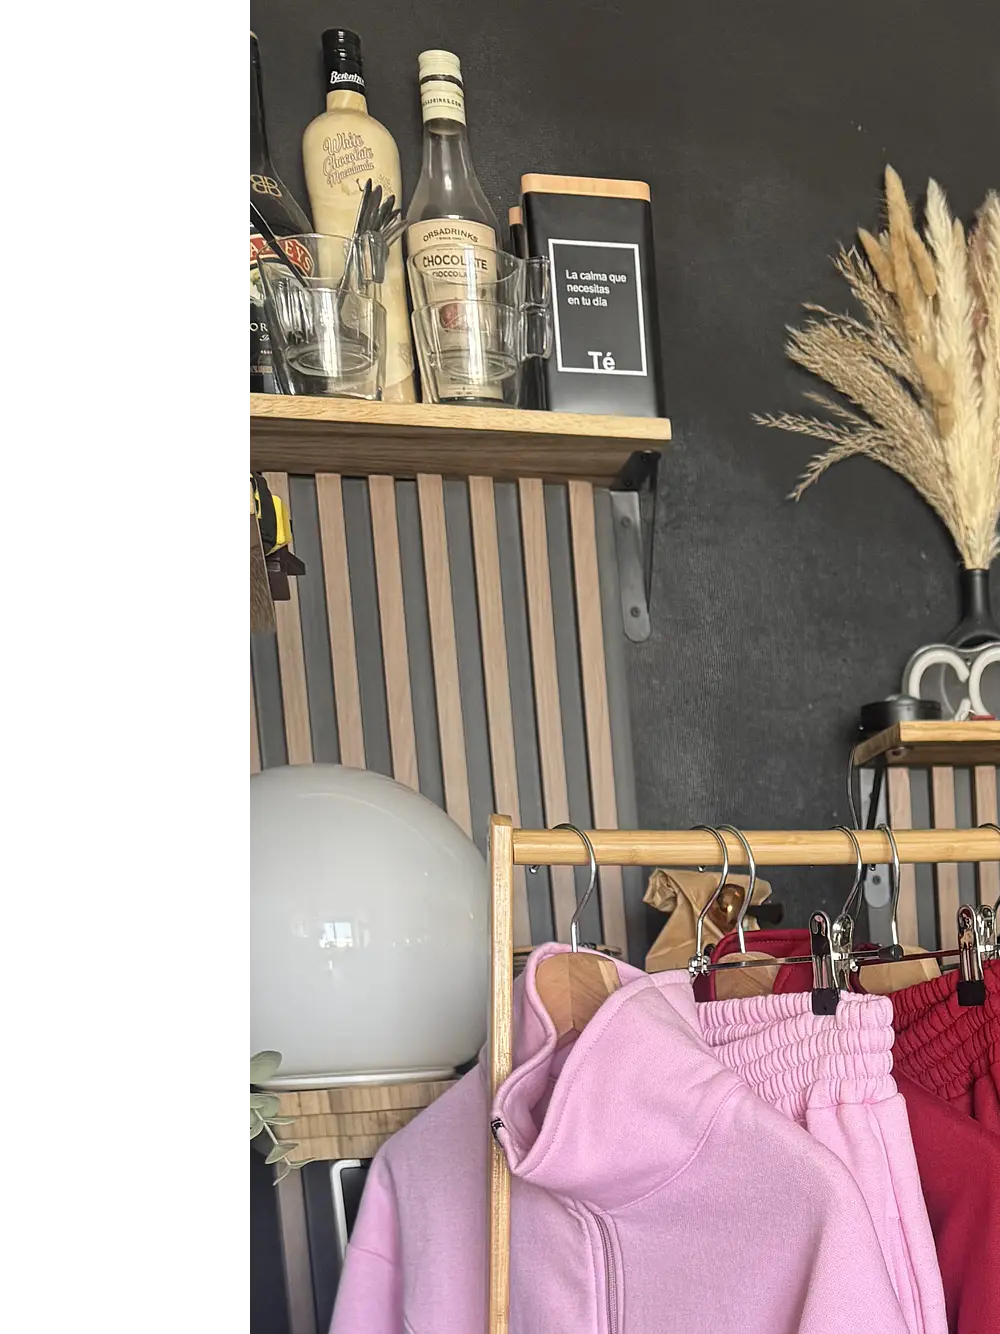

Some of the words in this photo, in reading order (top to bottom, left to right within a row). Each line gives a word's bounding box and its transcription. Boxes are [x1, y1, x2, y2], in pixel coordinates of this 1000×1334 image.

[323, 132, 364, 155] White
[323, 147, 374, 176] Chocolate
[423, 227, 478, 243] ORSADRINKS
[423, 254, 488, 270] CHOCOLTE
[565, 269, 578, 280] La
[580, 271, 607, 282] calma
[608, 273, 627, 284] que
[566, 284, 610, 294] necesitas
[567, 296, 580, 305] en
[581, 296, 591, 306] tu
[588, 351, 615, 371] Té
